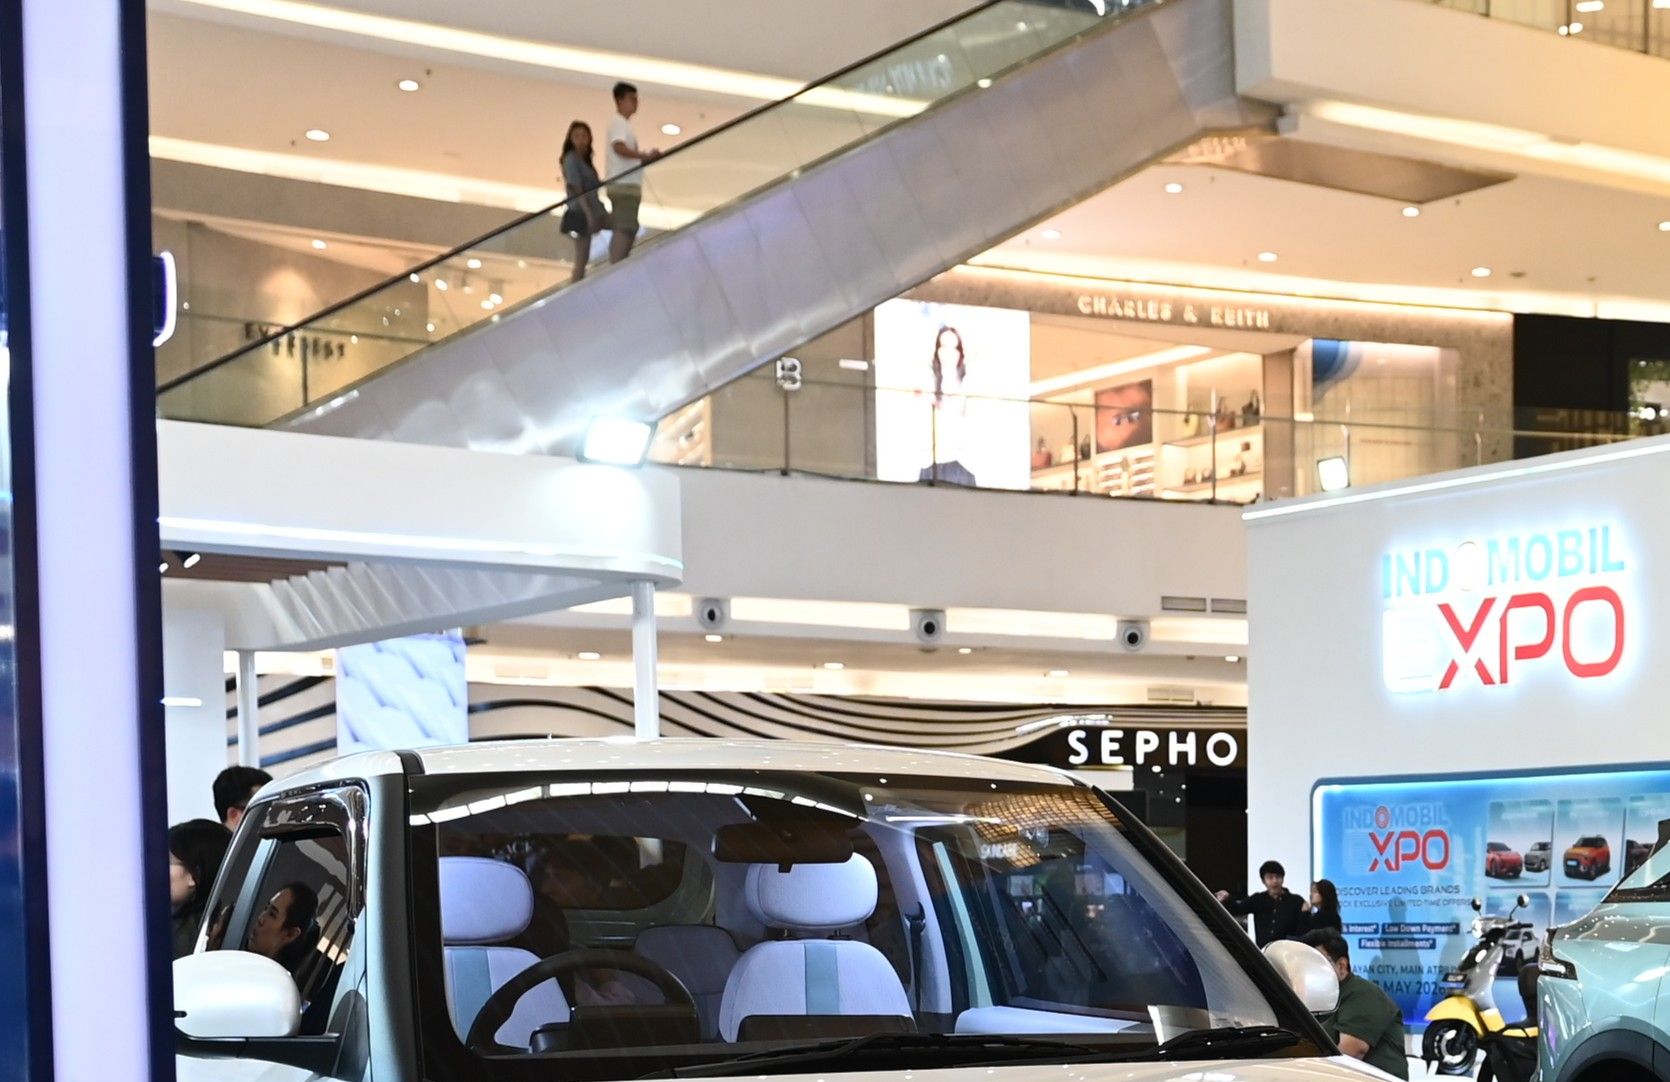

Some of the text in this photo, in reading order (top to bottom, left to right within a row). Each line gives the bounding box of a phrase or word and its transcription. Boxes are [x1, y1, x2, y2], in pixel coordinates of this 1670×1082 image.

[1077, 295, 1270, 328] CHARLES & KEITH
[1067, 729, 1238, 767] SEPHO
[1380, 885, 1419, 896] LEADING
[1420, 884, 1461, 895] BRANDS
[1383, 980, 1412, 994] MAY
